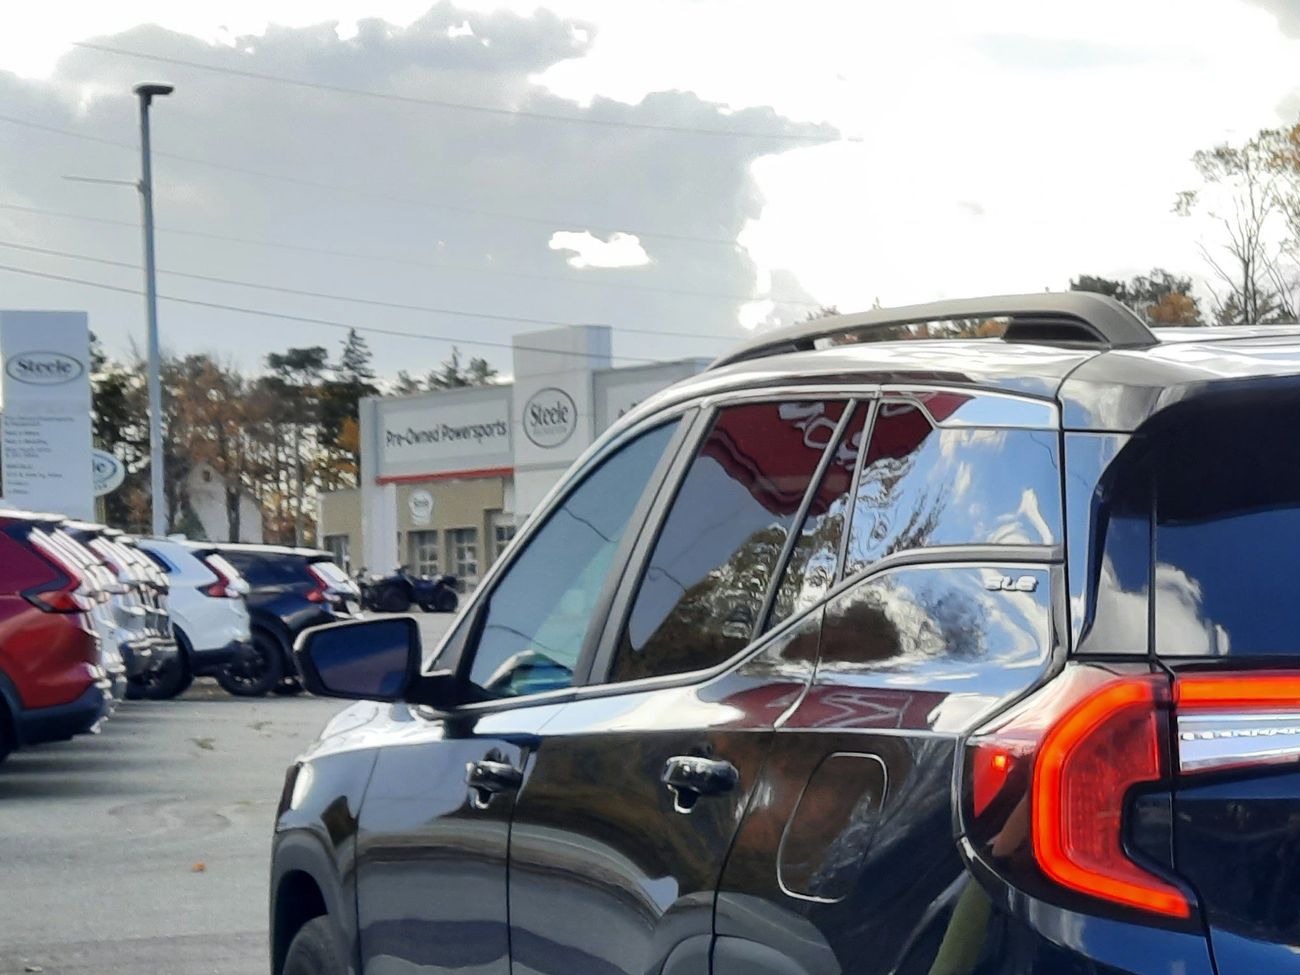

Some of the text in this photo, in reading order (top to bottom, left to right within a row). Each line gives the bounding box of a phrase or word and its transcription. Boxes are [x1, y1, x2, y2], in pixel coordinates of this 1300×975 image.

[530, 401, 569, 426] Steele
[386, 420, 507, 447] Pre-Owned Powersports
